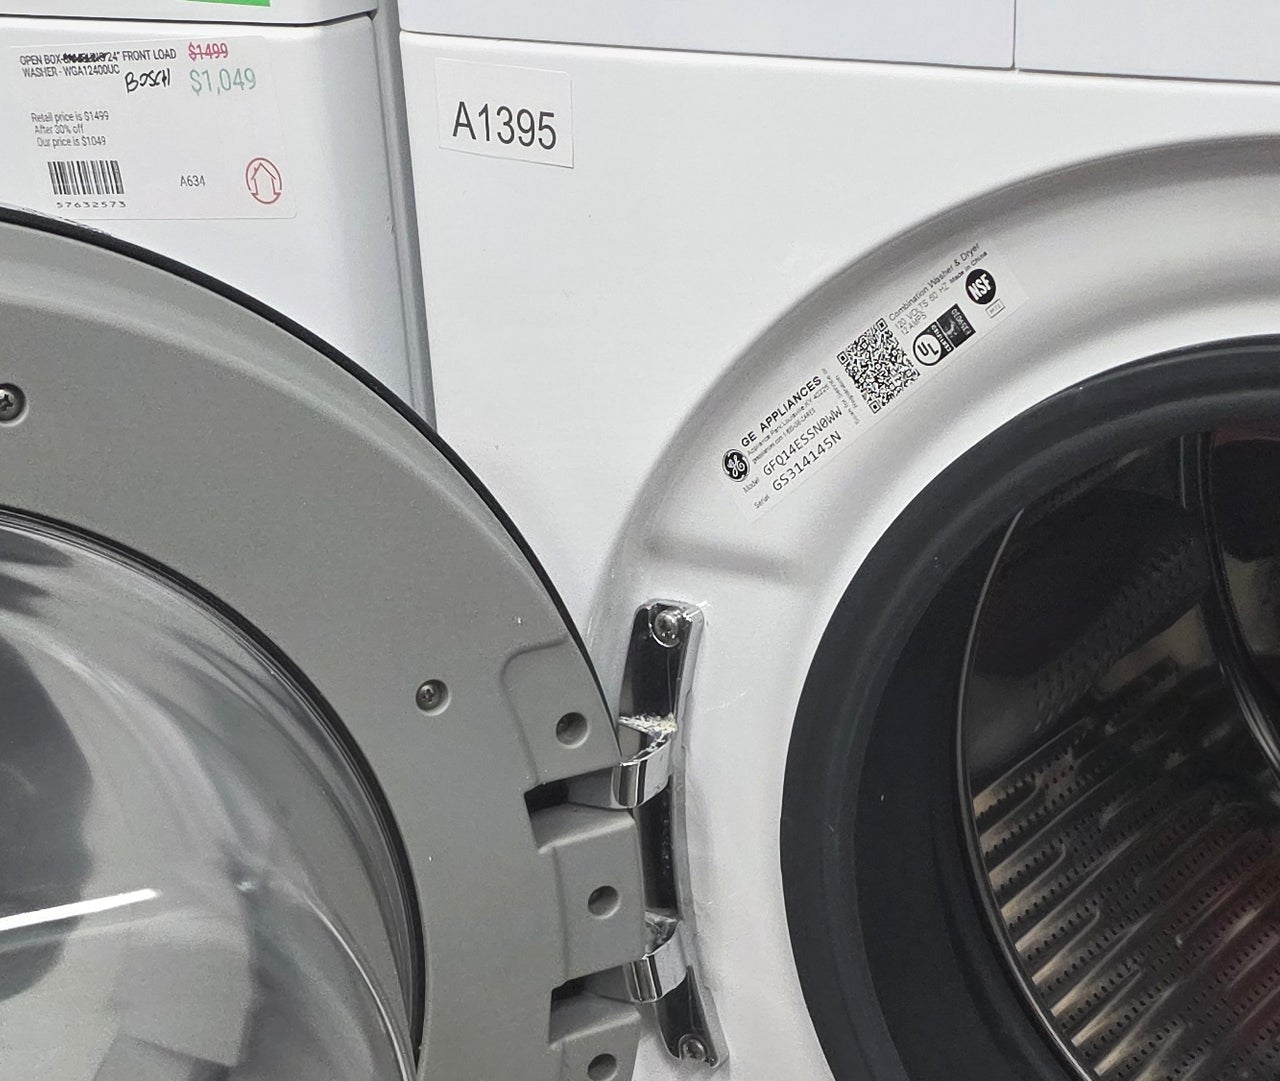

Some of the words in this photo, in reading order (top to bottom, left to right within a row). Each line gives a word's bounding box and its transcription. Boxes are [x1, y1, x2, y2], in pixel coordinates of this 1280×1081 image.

[20, 55, 42, 65] OPEN
[122, 50, 150, 60] FRONT
[153, 49, 176, 60] LOAD
[188, 42, 228, 61] $1499
[22, 67, 58, 77] WASHER
[63, 64, 120, 76] WGA12400UC
[190, 68, 256, 96] $1,049
[31, 112, 53, 122] Retail
[55, 112, 74, 124] price
[75, 112, 82, 121] is
[84, 111, 109, 121] $1499
[453, 101, 556, 150] A1395
[35, 125, 53, 134] After
[55, 125, 71, 134] 30%
[73, 124, 84, 133] off
[37, 137, 50, 147] Our
[52, 137, 72, 149] price
[73, 137, 80, 146] is
[81, 136, 106, 146] $1049
[180, 175, 206, 187] A634
[56, 201, 127, 209] 57632573
[888, 286, 929, 321] Combination
[928, 264, 953, 287] Washer
[960, 243, 979, 262] Dryer
[968, 273, 992, 300] NSF
[917, 342, 939, 356] UL
[741, 431, 757, 447] GE
[760, 376, 822, 432] APPLIANCES
[763, 406, 842, 476] GFQ14ESSN0WW
[772, 430, 842, 491] GS314145N
